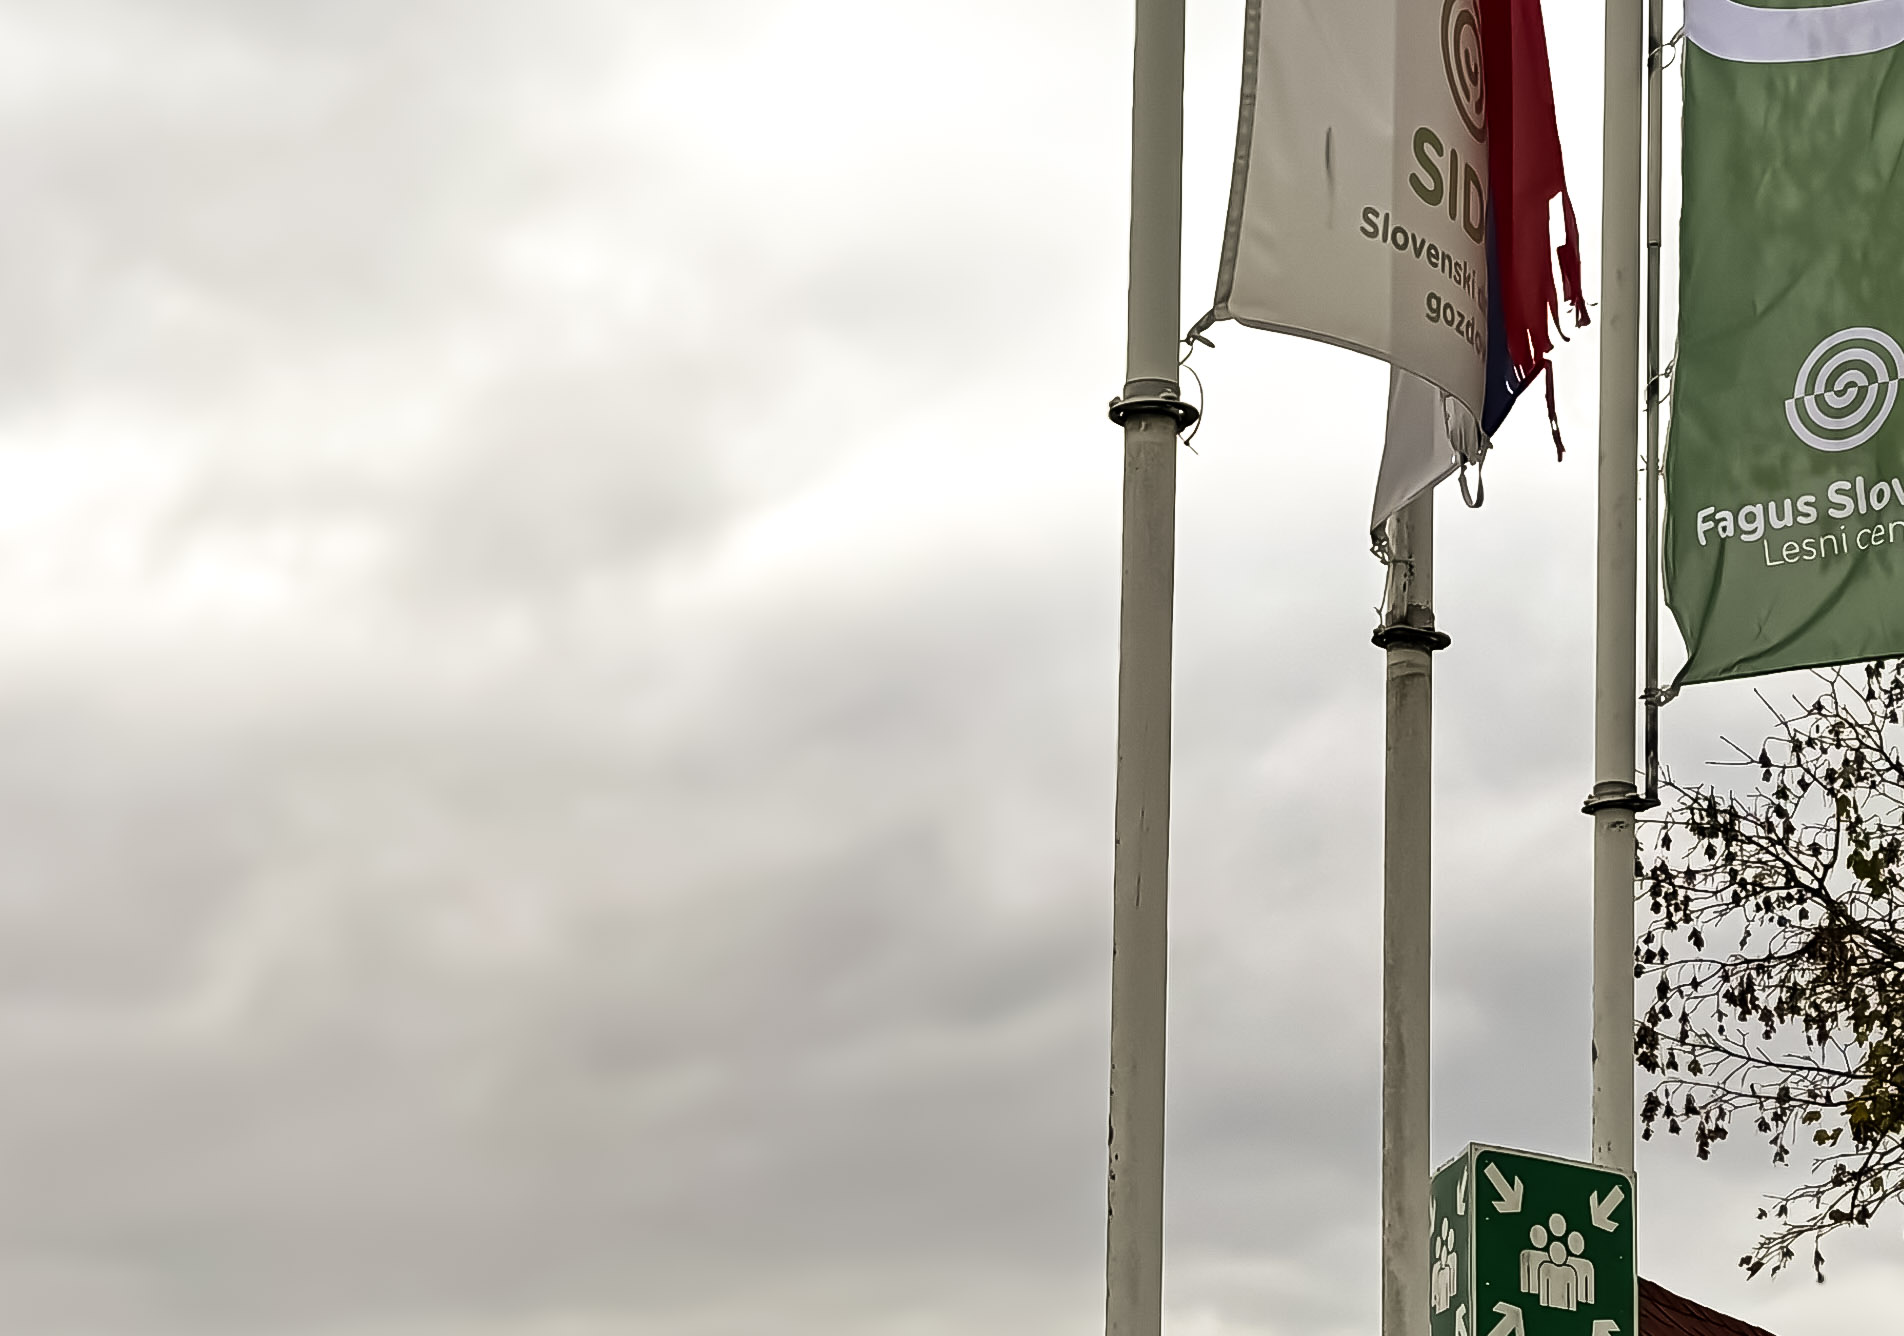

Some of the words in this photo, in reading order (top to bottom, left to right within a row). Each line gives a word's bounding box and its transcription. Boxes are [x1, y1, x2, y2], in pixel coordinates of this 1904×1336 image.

[1359, 206, 1476, 300] Slovenski
[1425, 291, 1486, 362] gozdo
[1696, 494, 1818, 546] Fagus
[1763, 525, 1848, 566] Lesni
